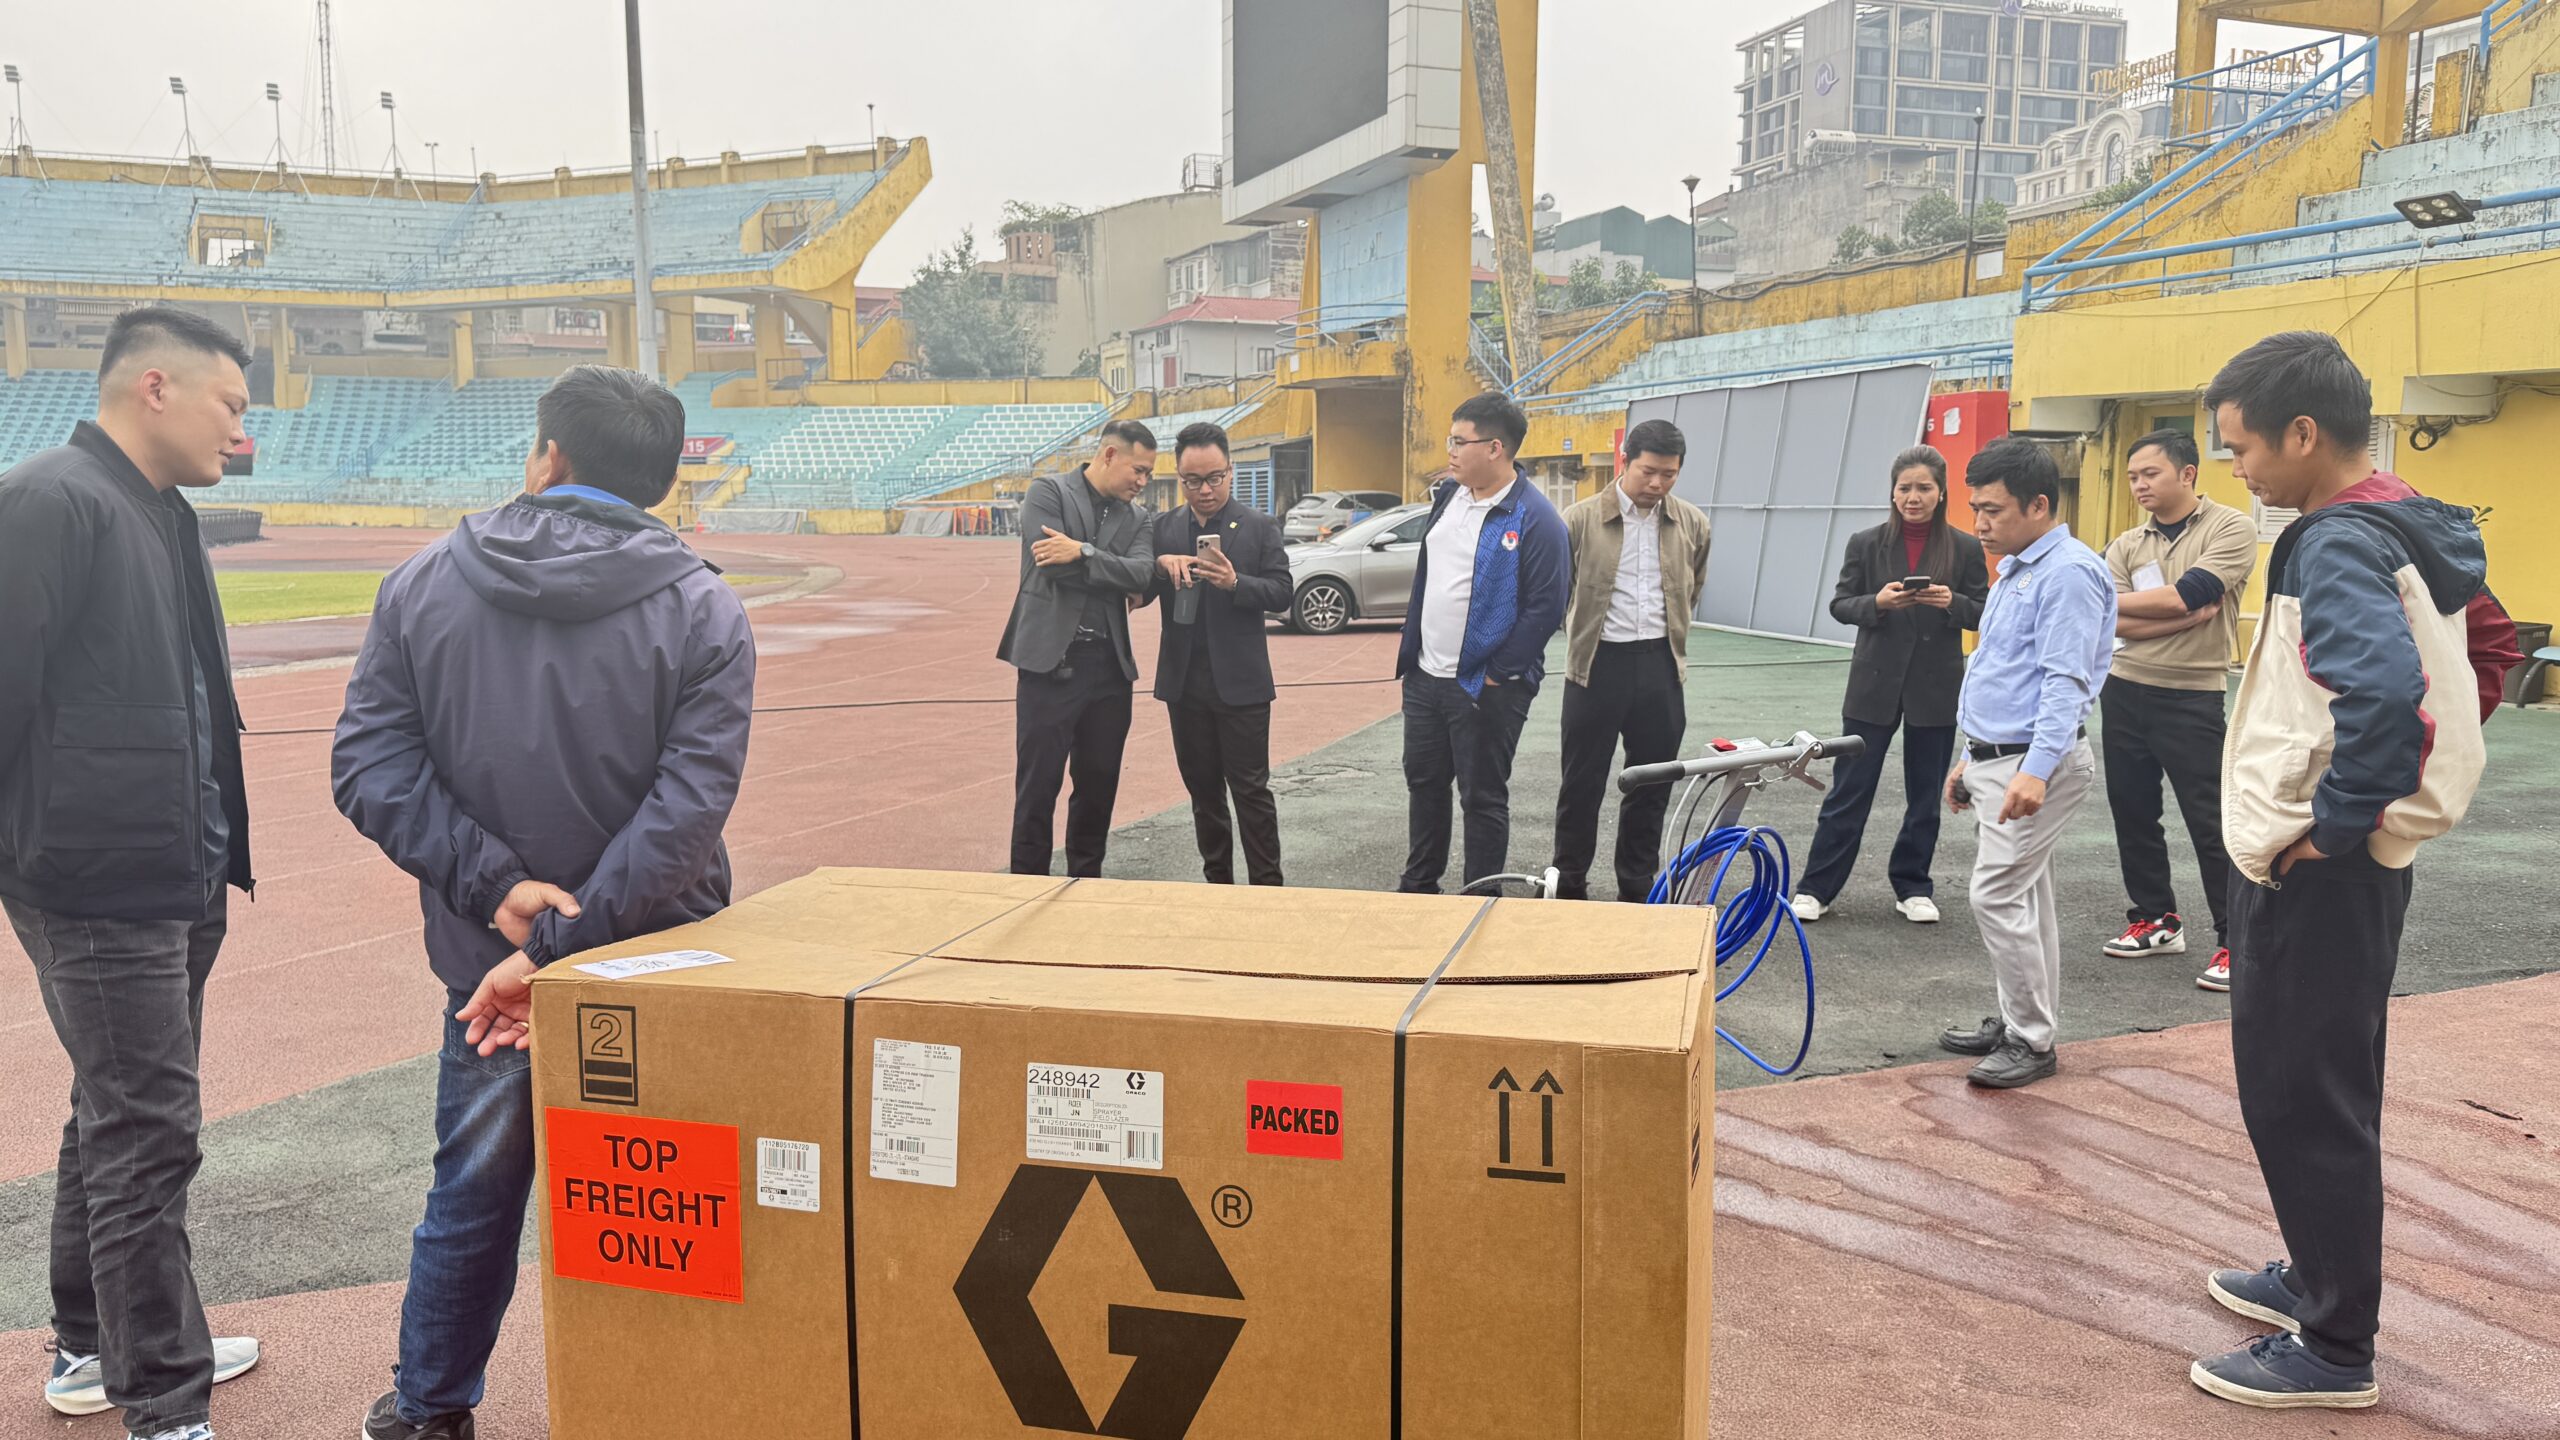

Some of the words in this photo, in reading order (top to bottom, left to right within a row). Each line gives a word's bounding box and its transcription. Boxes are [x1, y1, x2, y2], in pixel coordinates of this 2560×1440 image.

[687, 440, 705, 453] 15
[590, 1013, 624, 1057] 2
[1029, 1069, 1100, 1088] 248942
[1250, 1104, 1340, 1137] PACKED
[603, 1134, 679, 1174] TOP
[565, 1178, 727, 1229] FREIGHT
[598, 1229, 695, 1273] ONLY
